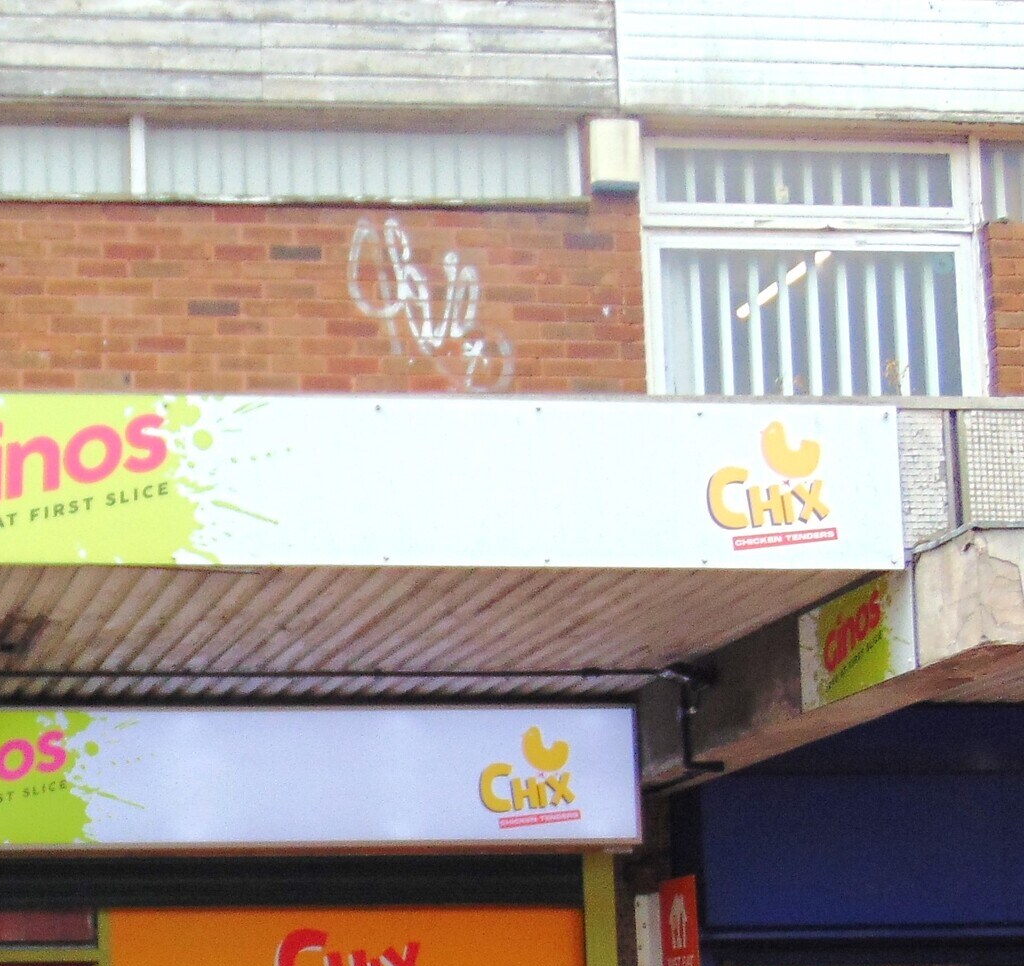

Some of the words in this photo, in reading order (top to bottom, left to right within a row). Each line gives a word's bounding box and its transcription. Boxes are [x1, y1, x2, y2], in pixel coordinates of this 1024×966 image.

[29, 497, 94, 522] FIRST
[105, 481, 169, 507] SLICE
[734, 535, 783, 547] CHICKEN
[785, 530, 835, 543] TENDERS
[22, 780, 68, 798] SLICE
